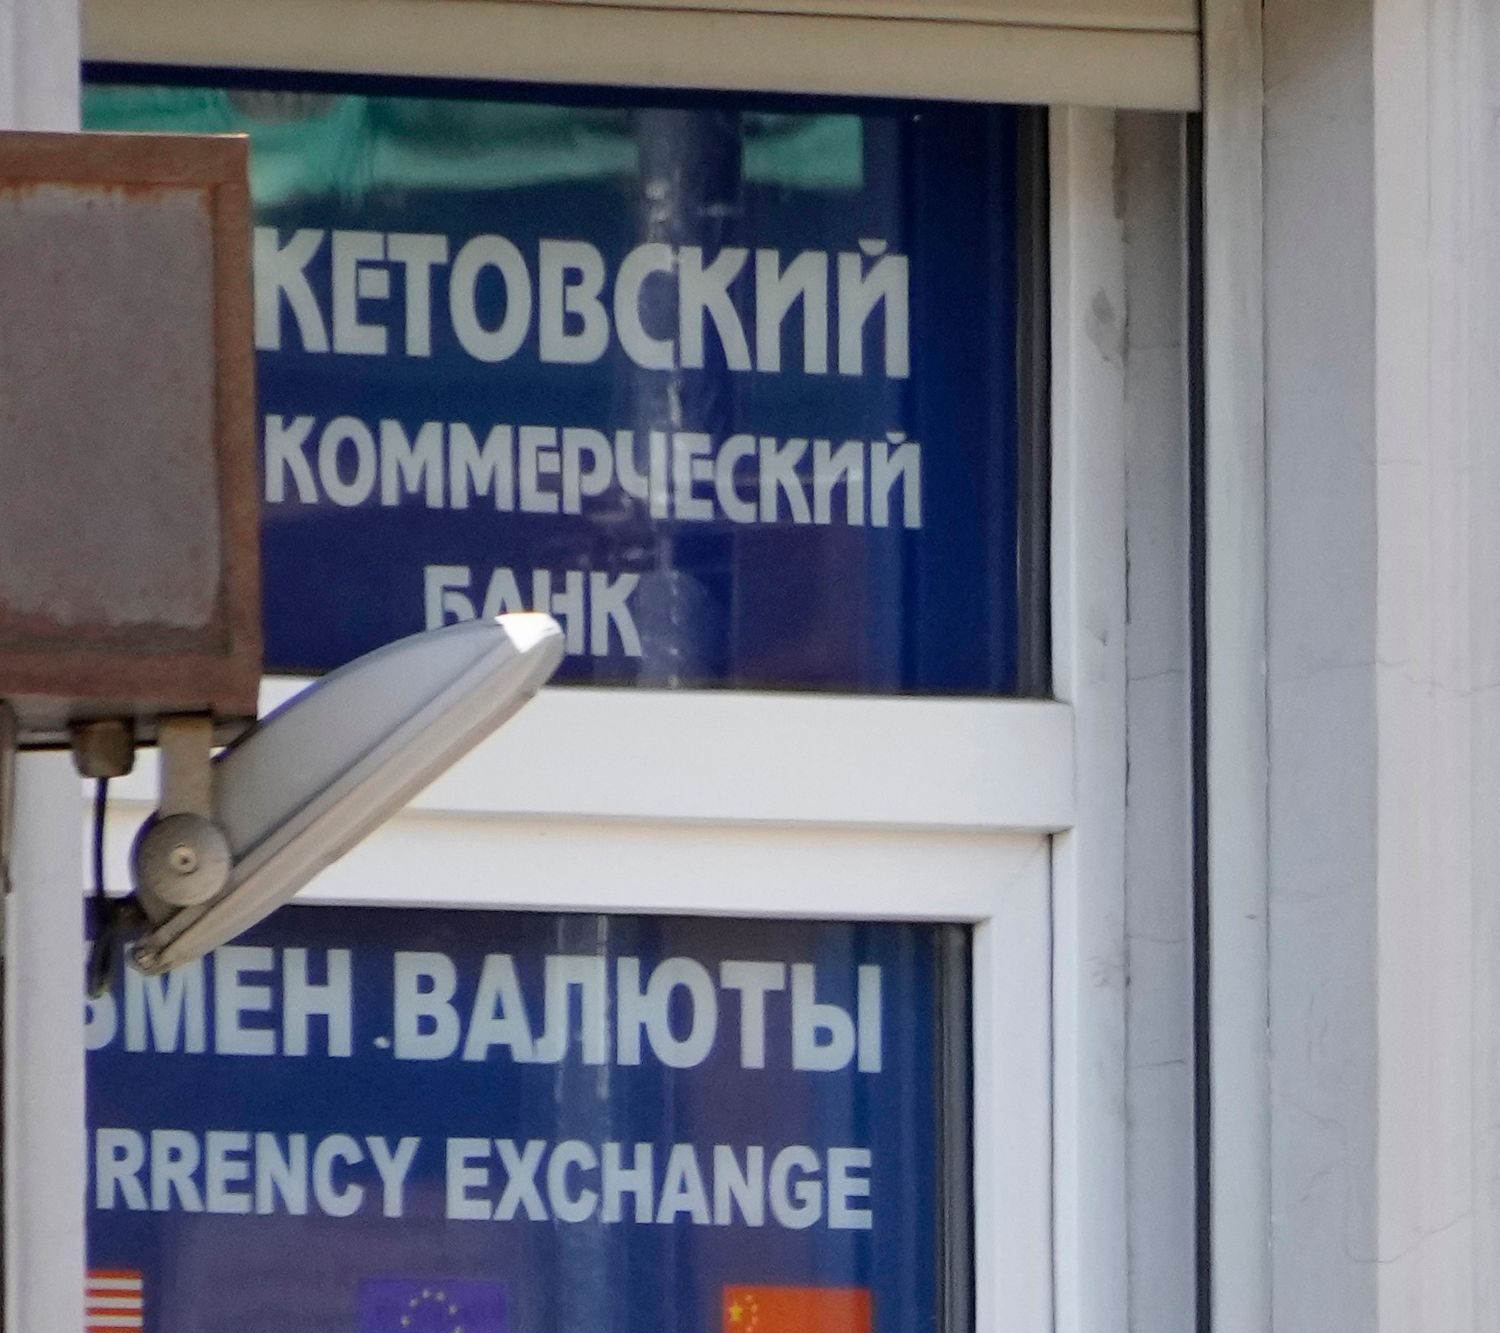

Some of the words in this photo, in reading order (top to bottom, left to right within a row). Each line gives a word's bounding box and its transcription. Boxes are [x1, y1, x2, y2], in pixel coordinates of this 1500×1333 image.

[255, 227, 911, 379] КЕТОВСКИЙ
[264, 416, 923, 530] КОММЕРЧЕСКИЙ
[424, 564, 643, 657] БАНК
[394, 949, 883, 1073] ВАЛЮТЫ
[445, 1137, 873, 1230] EXCHANGE
